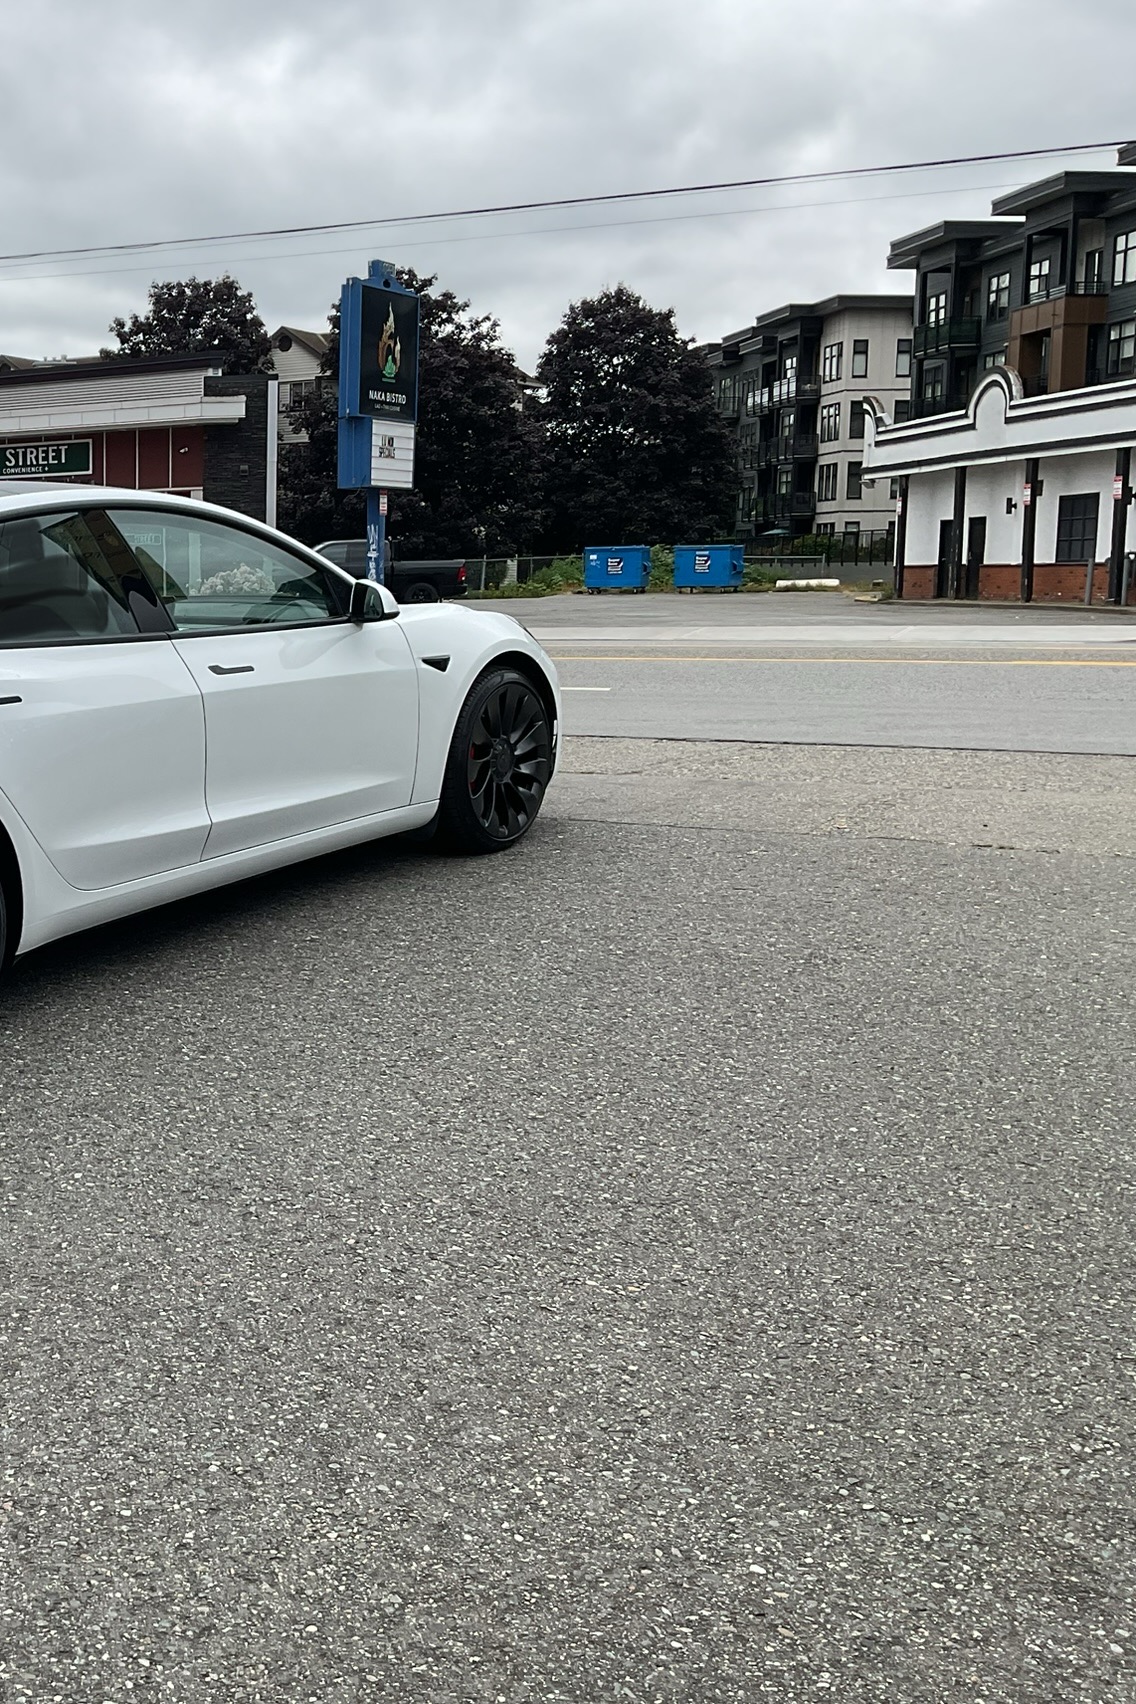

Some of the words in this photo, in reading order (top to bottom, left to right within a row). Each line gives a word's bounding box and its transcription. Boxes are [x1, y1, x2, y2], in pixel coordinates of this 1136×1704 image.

[369, 390, 385, 401] NAKA
[386, 392, 406, 404] BISTRO
[5, 445, 68, 467] STREET
[2, 466, 43, 475] CONVENIENCE
